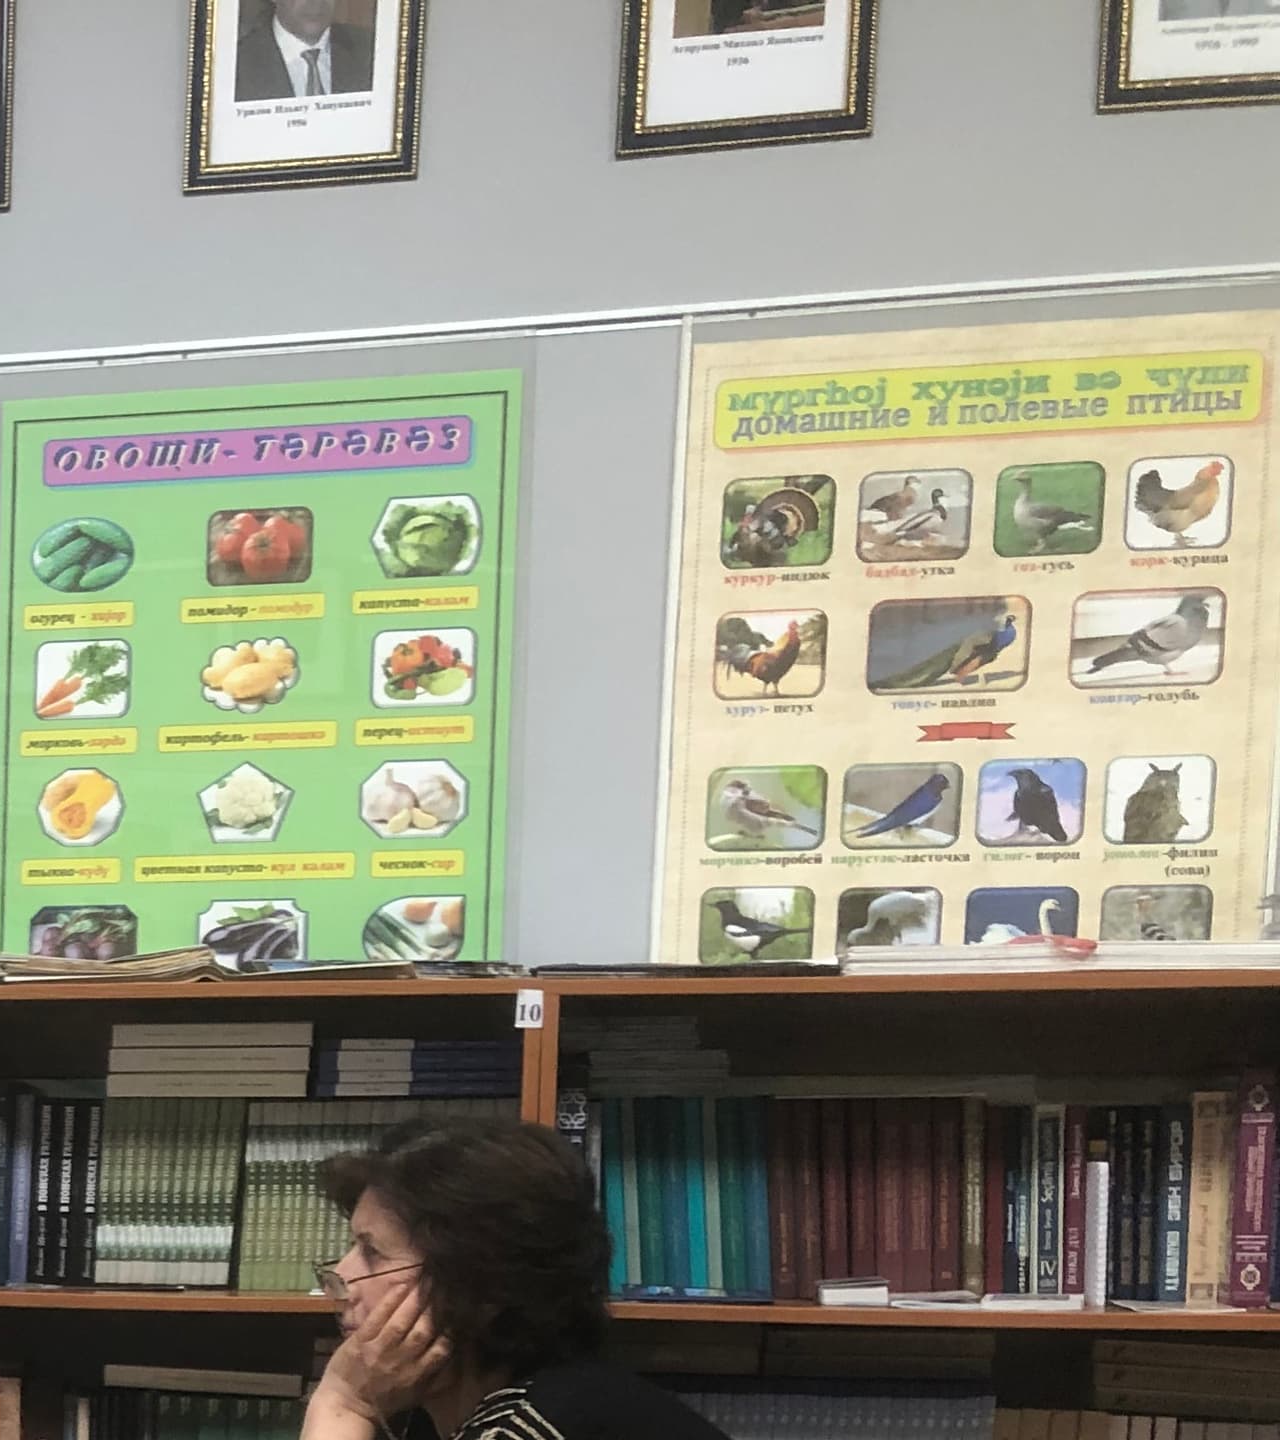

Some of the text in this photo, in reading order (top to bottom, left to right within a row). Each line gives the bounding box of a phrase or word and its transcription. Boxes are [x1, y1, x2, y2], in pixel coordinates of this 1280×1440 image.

[732, 389, 1243, 442] домашние и полевые птицы
[518, 1004, 541, 1021] 10
